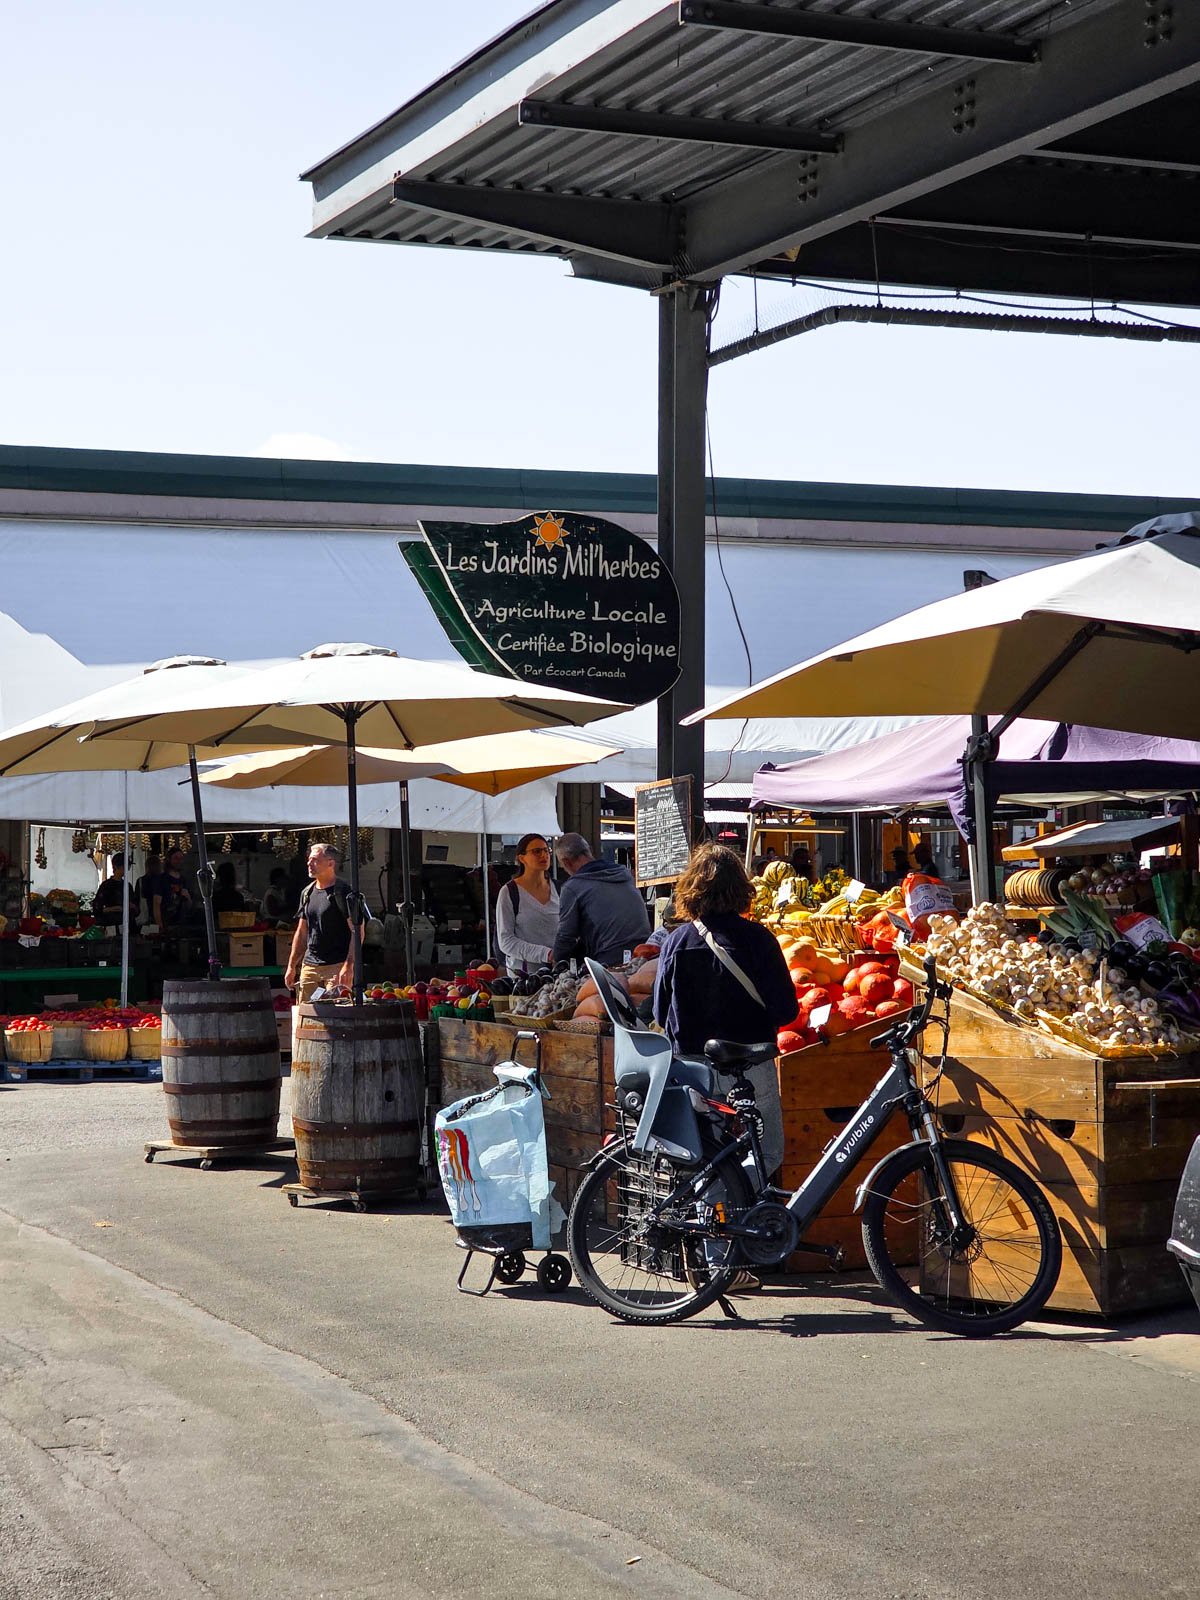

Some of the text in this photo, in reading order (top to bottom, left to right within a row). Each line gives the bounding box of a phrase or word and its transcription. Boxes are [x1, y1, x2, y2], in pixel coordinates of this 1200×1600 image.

[446, 540, 661, 580] Les Jardins Mil'herbes
[475, 599, 667, 624] Agriculture Locale
[497, 631, 677, 663] Certifiée Biologique
[524, 663, 626, 678] Par Écocert Canada
[843, 1115, 874, 1154] yulbike
